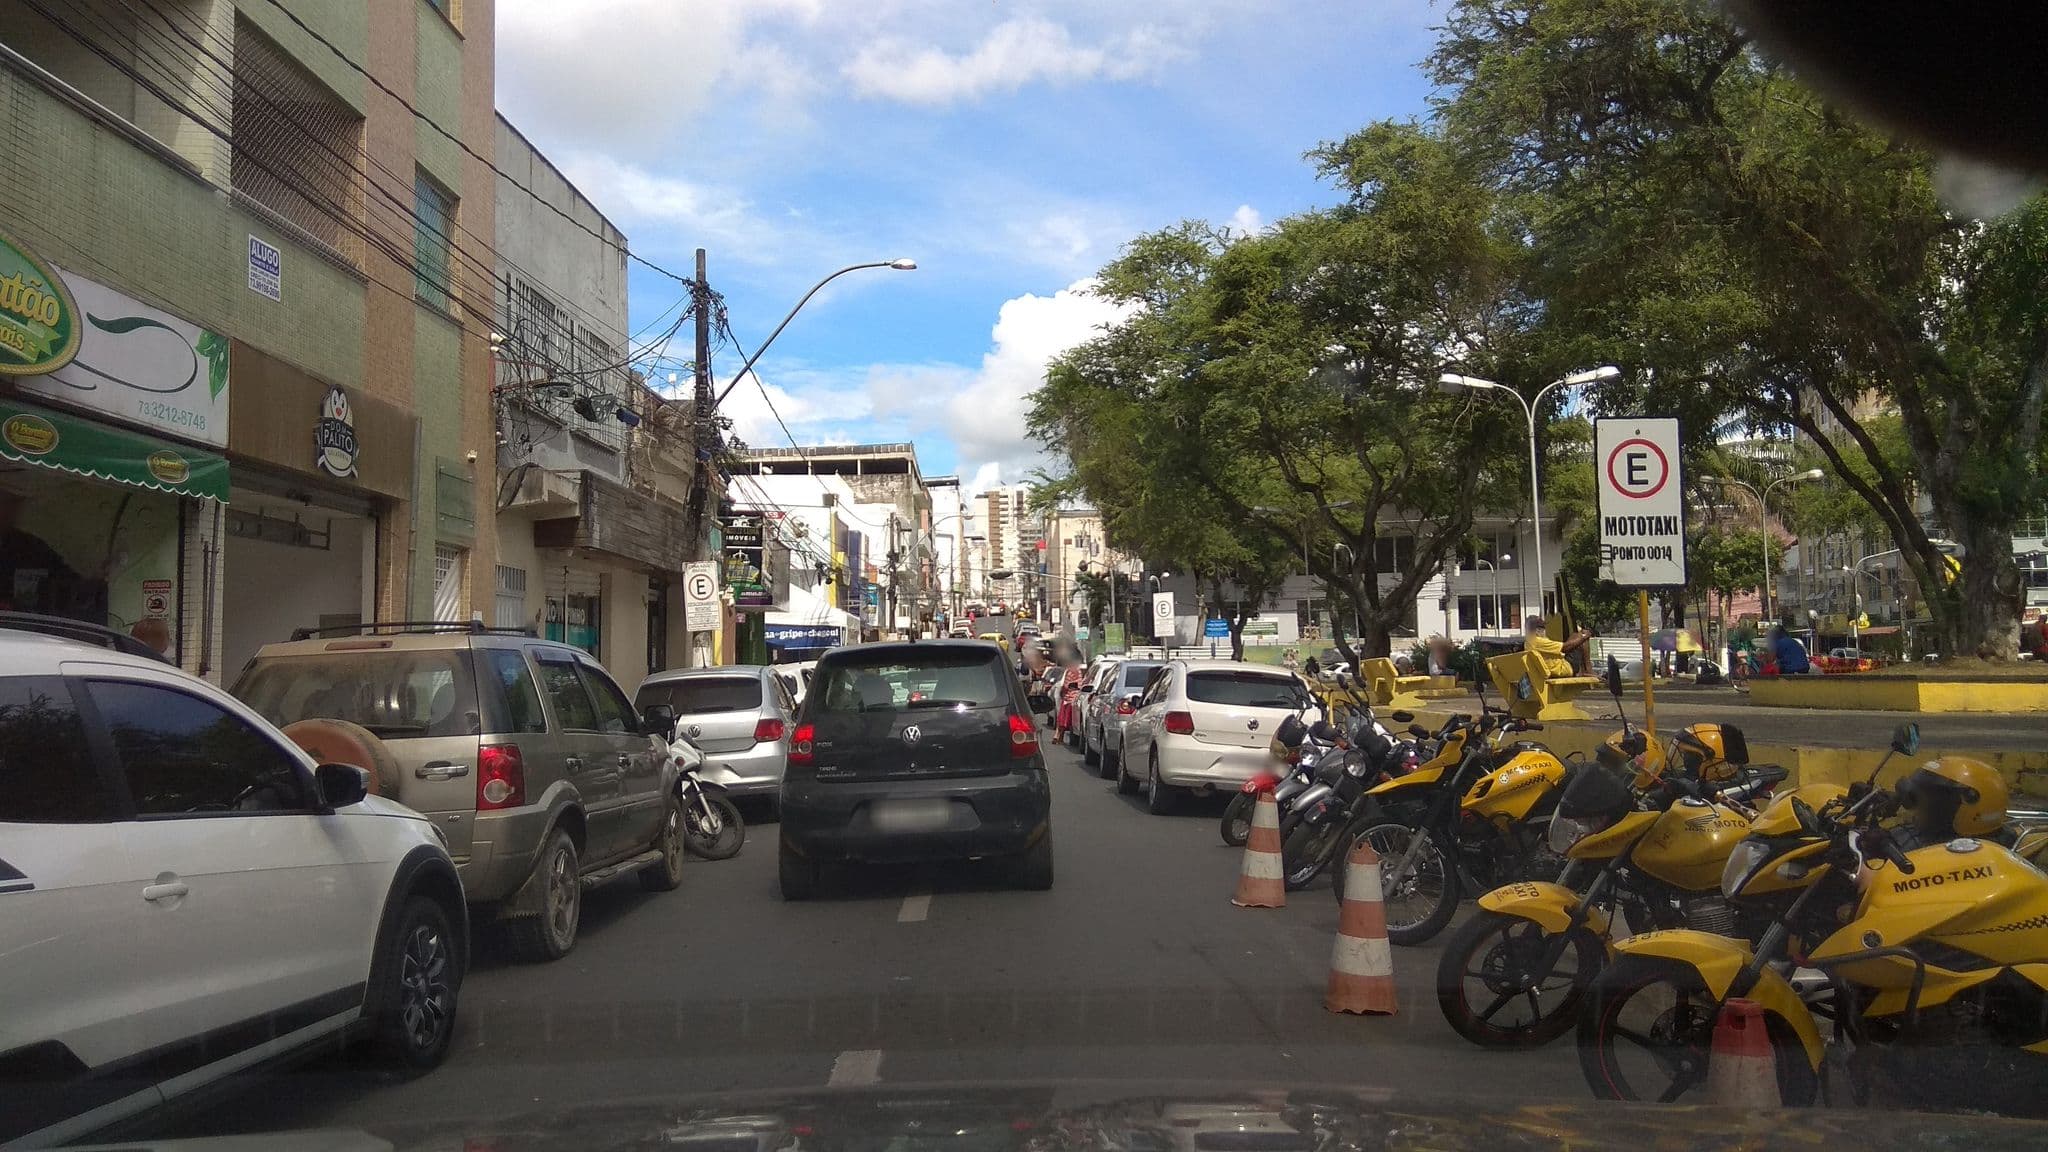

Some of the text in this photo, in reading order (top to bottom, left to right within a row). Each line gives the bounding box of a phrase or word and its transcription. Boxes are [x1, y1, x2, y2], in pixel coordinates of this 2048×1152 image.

[251, 240, 279, 267] ALUGO
[151, 401, 206, 430] 3212-8748
[330, 420, 347, 434] DOM
[324, 429, 353, 453] PALITO
[1627, 453, 1648, 485] E
[1612, 546, 1672, 561] PONTO 0014
[696, 578, 706, 595] E
[1160, 603, 1167, 614] E
[1893, 866, 1993, 893] MOTO-TAXI
